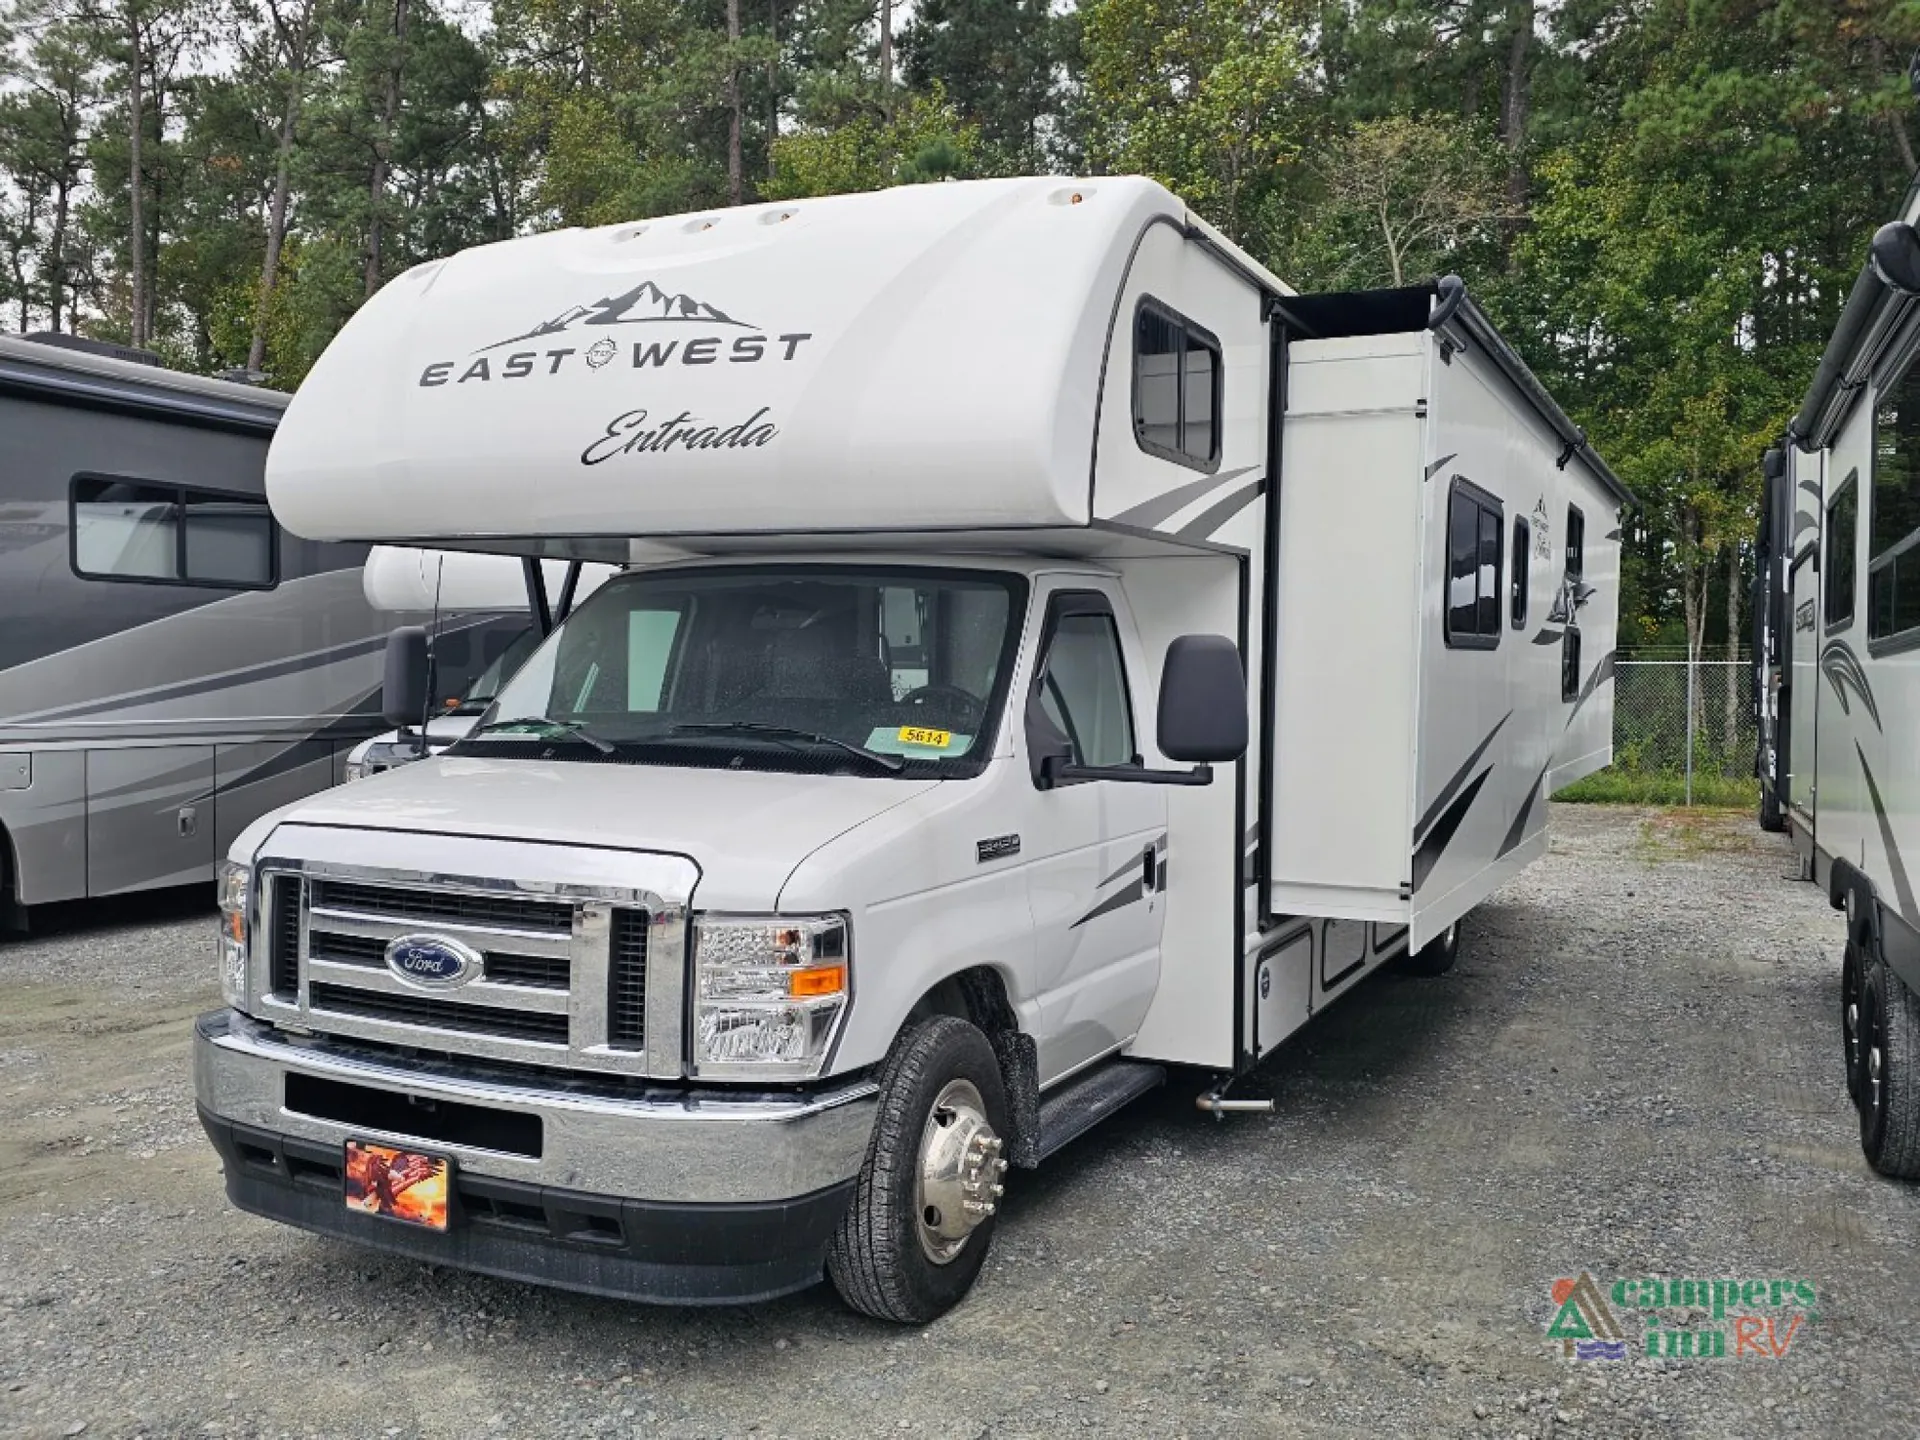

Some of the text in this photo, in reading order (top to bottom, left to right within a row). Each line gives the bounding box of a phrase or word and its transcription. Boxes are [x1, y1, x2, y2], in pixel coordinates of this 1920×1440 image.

[419, 333, 813, 387] EAST WEST
[580, 406, 780, 466] Entrada
[905, 728, 944, 745] 5614
[404, 948, 444, 973] Ford
